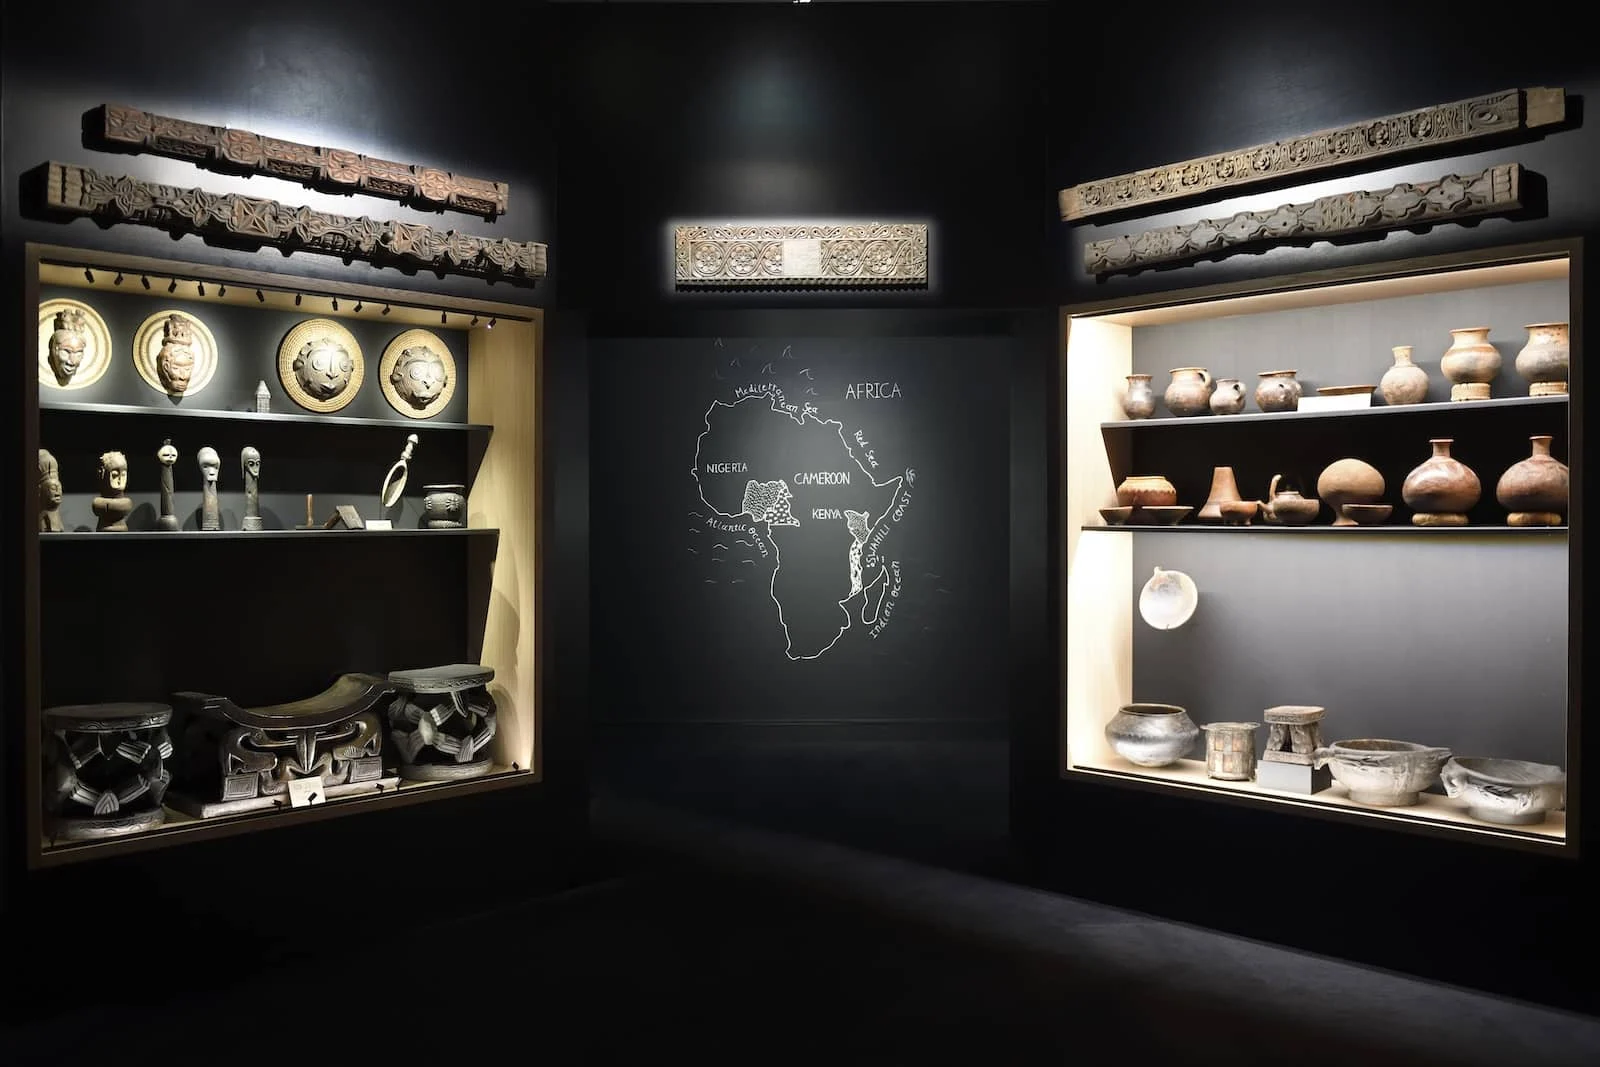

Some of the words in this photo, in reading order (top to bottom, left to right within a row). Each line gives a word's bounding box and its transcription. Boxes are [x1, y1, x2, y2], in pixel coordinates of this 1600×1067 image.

[735, 382, 798, 413] Mediterranean
[802, 402, 818, 414] Sea
[846, 383, 902, 399] AFRICA
[854, 430, 869, 448] Red
[865, 450, 879, 469] Sea
[706, 462, 748, 473] NIGERIA
[794, 472, 850, 485] CAMEROON
[812, 508, 842, 520] KENYA
[866, 524, 890, 563] SWAHILI
[892, 490, 912, 522] COAST
[705, 517, 747, 532] Atlantic
[748, 527, 769, 558] Ocean
[869, 601, 895, 639] Indian
[891, 560, 902, 598] Ocean
